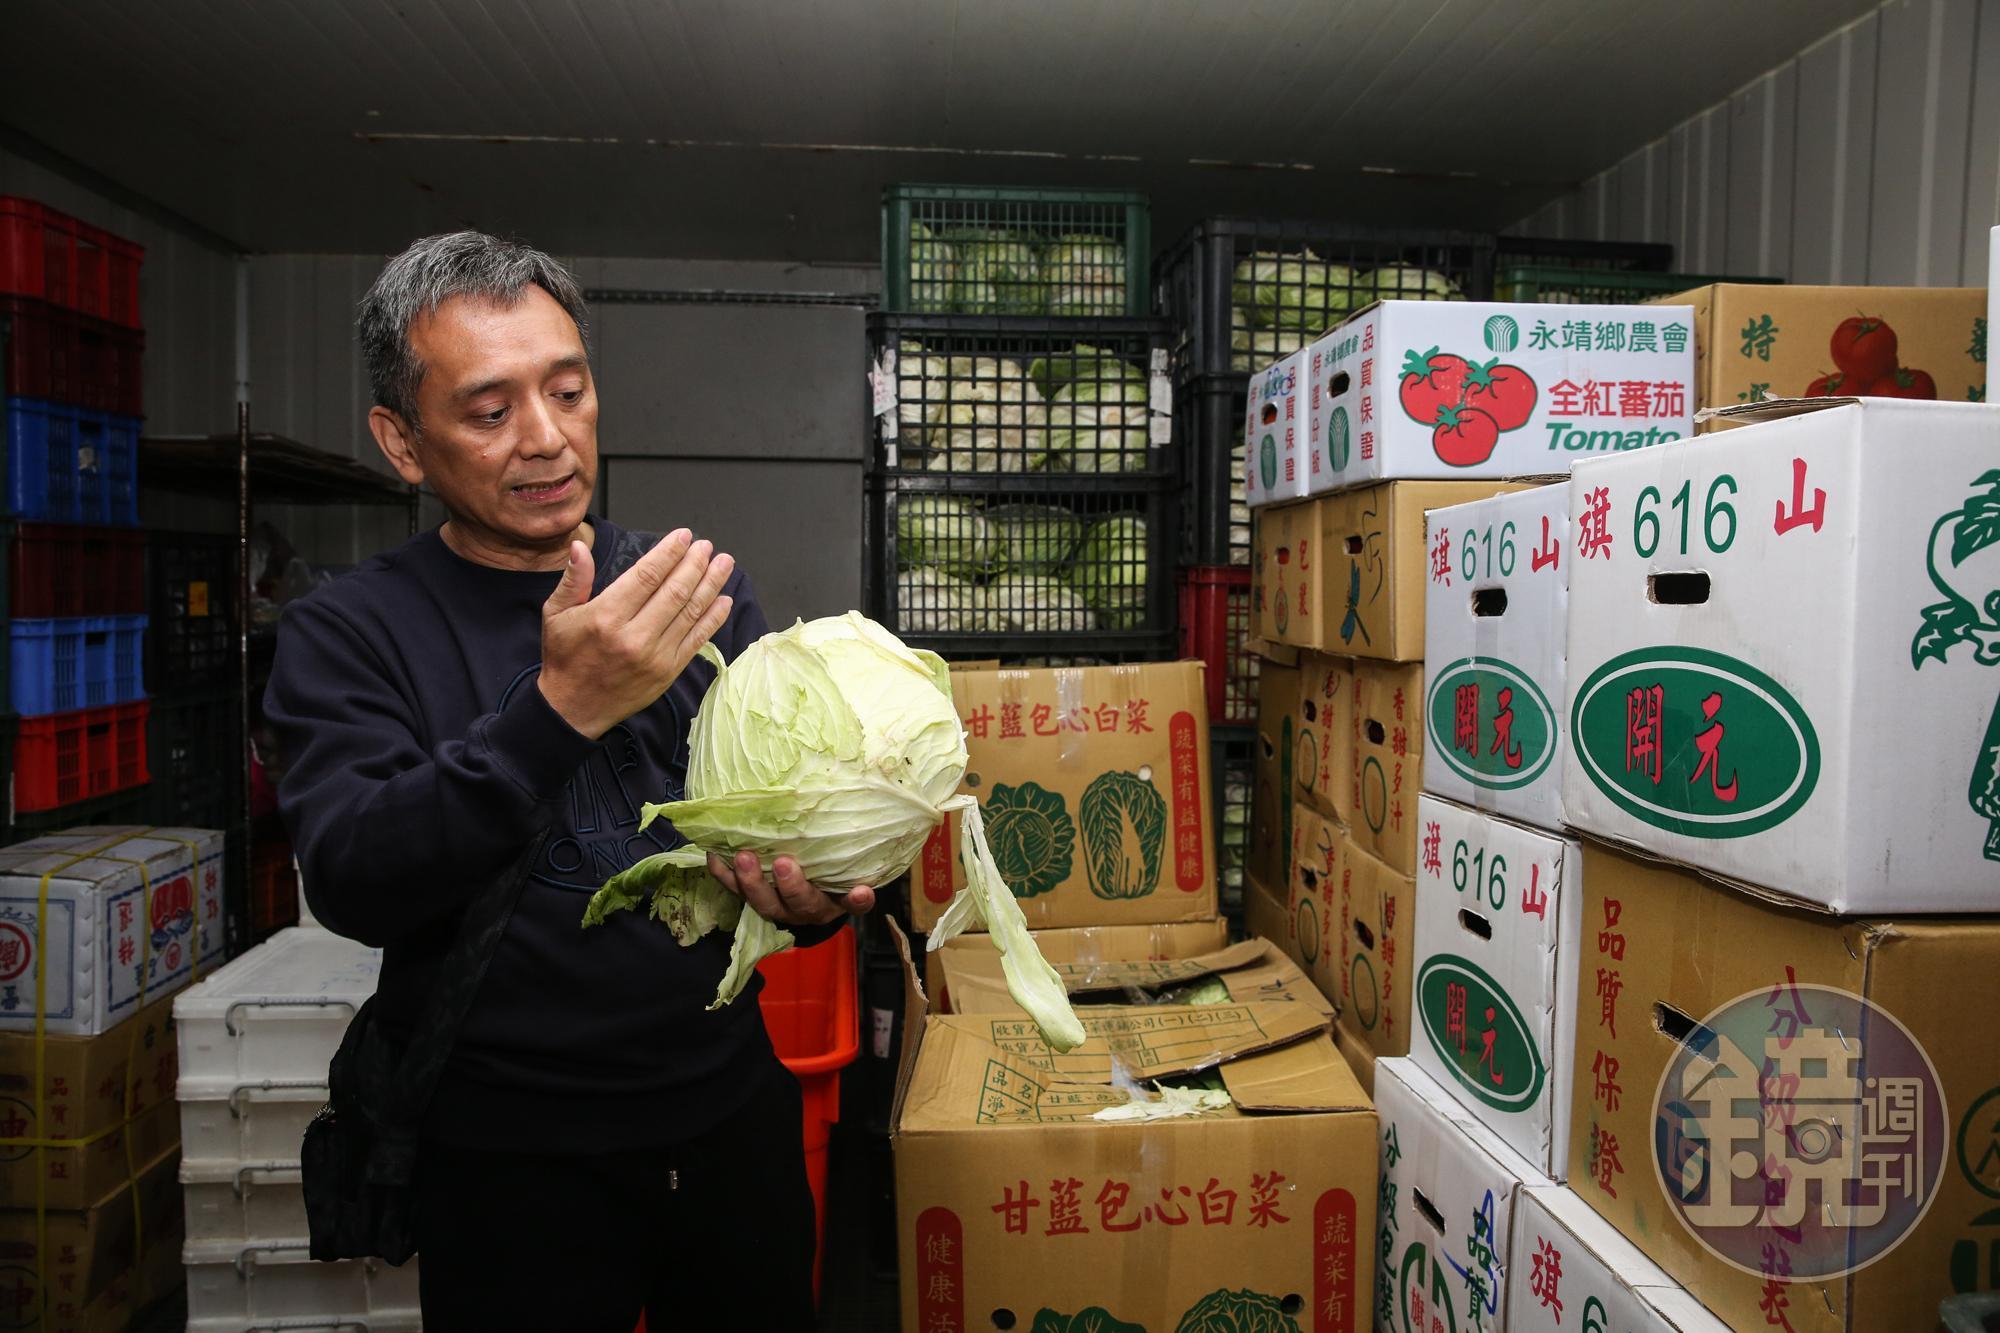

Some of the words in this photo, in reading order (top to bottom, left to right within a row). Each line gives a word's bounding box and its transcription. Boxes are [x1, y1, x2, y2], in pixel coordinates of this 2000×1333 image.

[1528, 320, 1688, 353] 永靖鄉農會
[1548, 379, 1685, 417] 全紅蕃茄
[1430, 527, 1451, 587] 旗
[1462, 521, 1516, 582] 616
[1532, 515, 1560, 573] 山
[1578, 485, 1612, 560] 旗
[1633, 473, 1738, 558] 616
[1774, 458, 1827, 536] 山
[965, 699, 1154, 740] 甘藍包心白菜
[1454, 682, 1522, 769] 開元
[1626, 683, 1738, 802] 開元
[1175, 728, 1199, 878] 蔬菜有益健康
[928, 825, 948, 889] 泉源
[1423, 821, 1442, 879] 旗
[1452, 839, 1507, 910] 616
[1521, 863, 1547, 922] 山
[1446, 982, 1503, 1086] 開元
[1589, 897, 1626, 1199] 品質保證
[1757, 965, 1813, 1333] 分級包裝
[992, 1170, 1291, 1237] 甘藍包心白菜
[1380, 1122, 1402, 1333] 分級包裝
[1530, 1232, 1563, 1326] 旗
